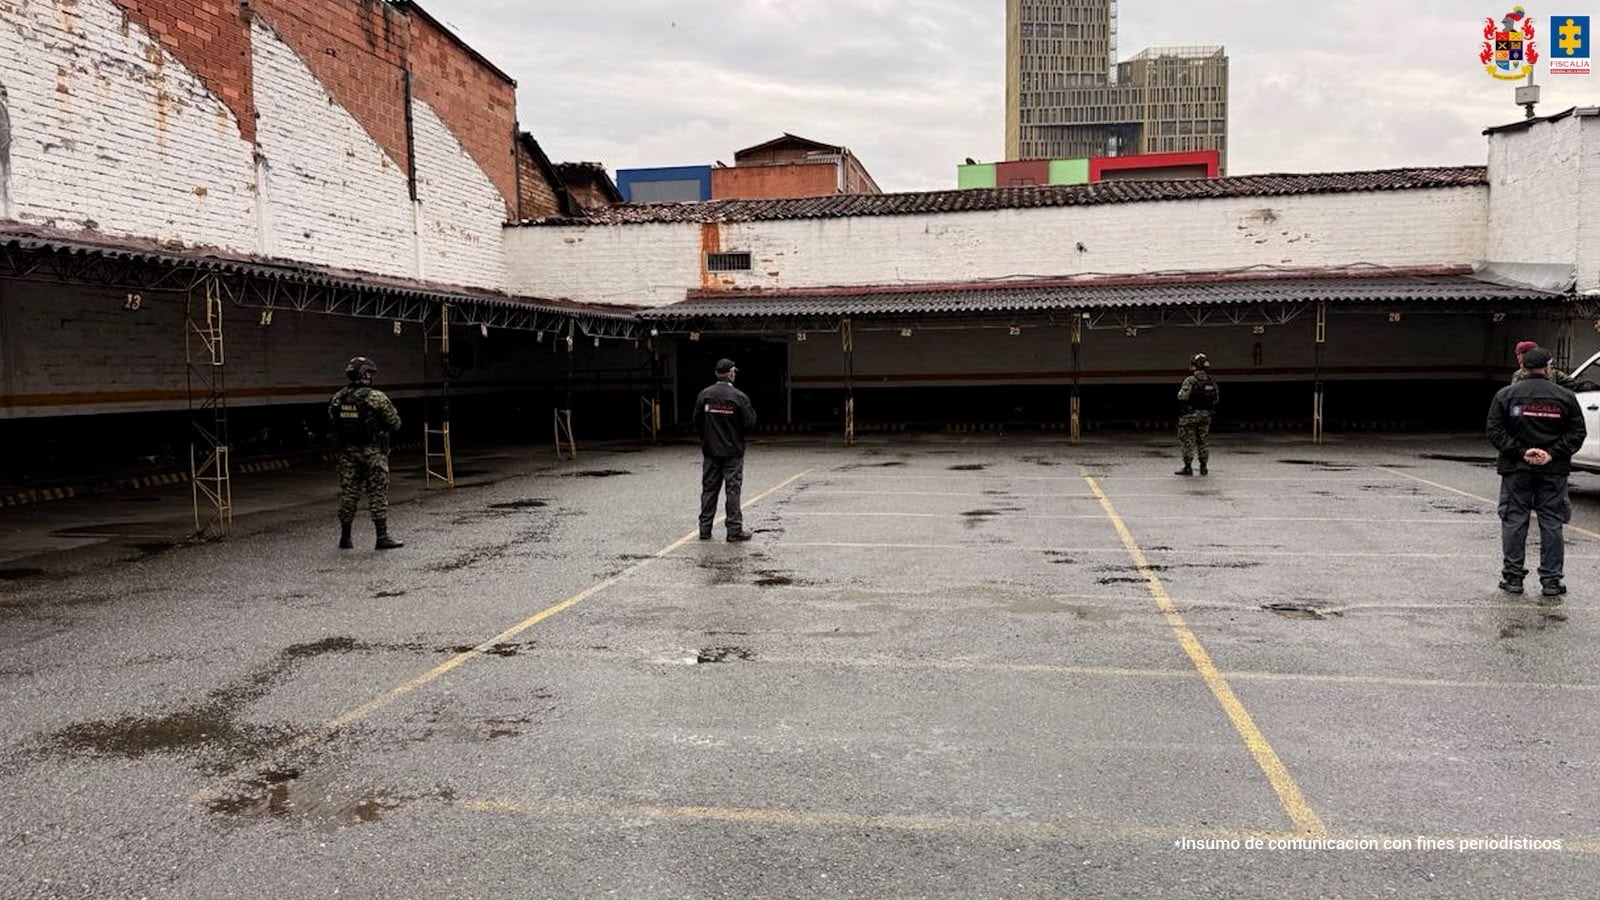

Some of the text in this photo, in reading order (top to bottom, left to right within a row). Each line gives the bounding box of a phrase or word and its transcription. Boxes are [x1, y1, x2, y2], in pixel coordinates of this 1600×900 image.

[125, 294, 142, 310] 13
[260, 311, 273, 325] 14
[1493, 313, 1505, 322] 27
[796, 332, 807, 341] 21
